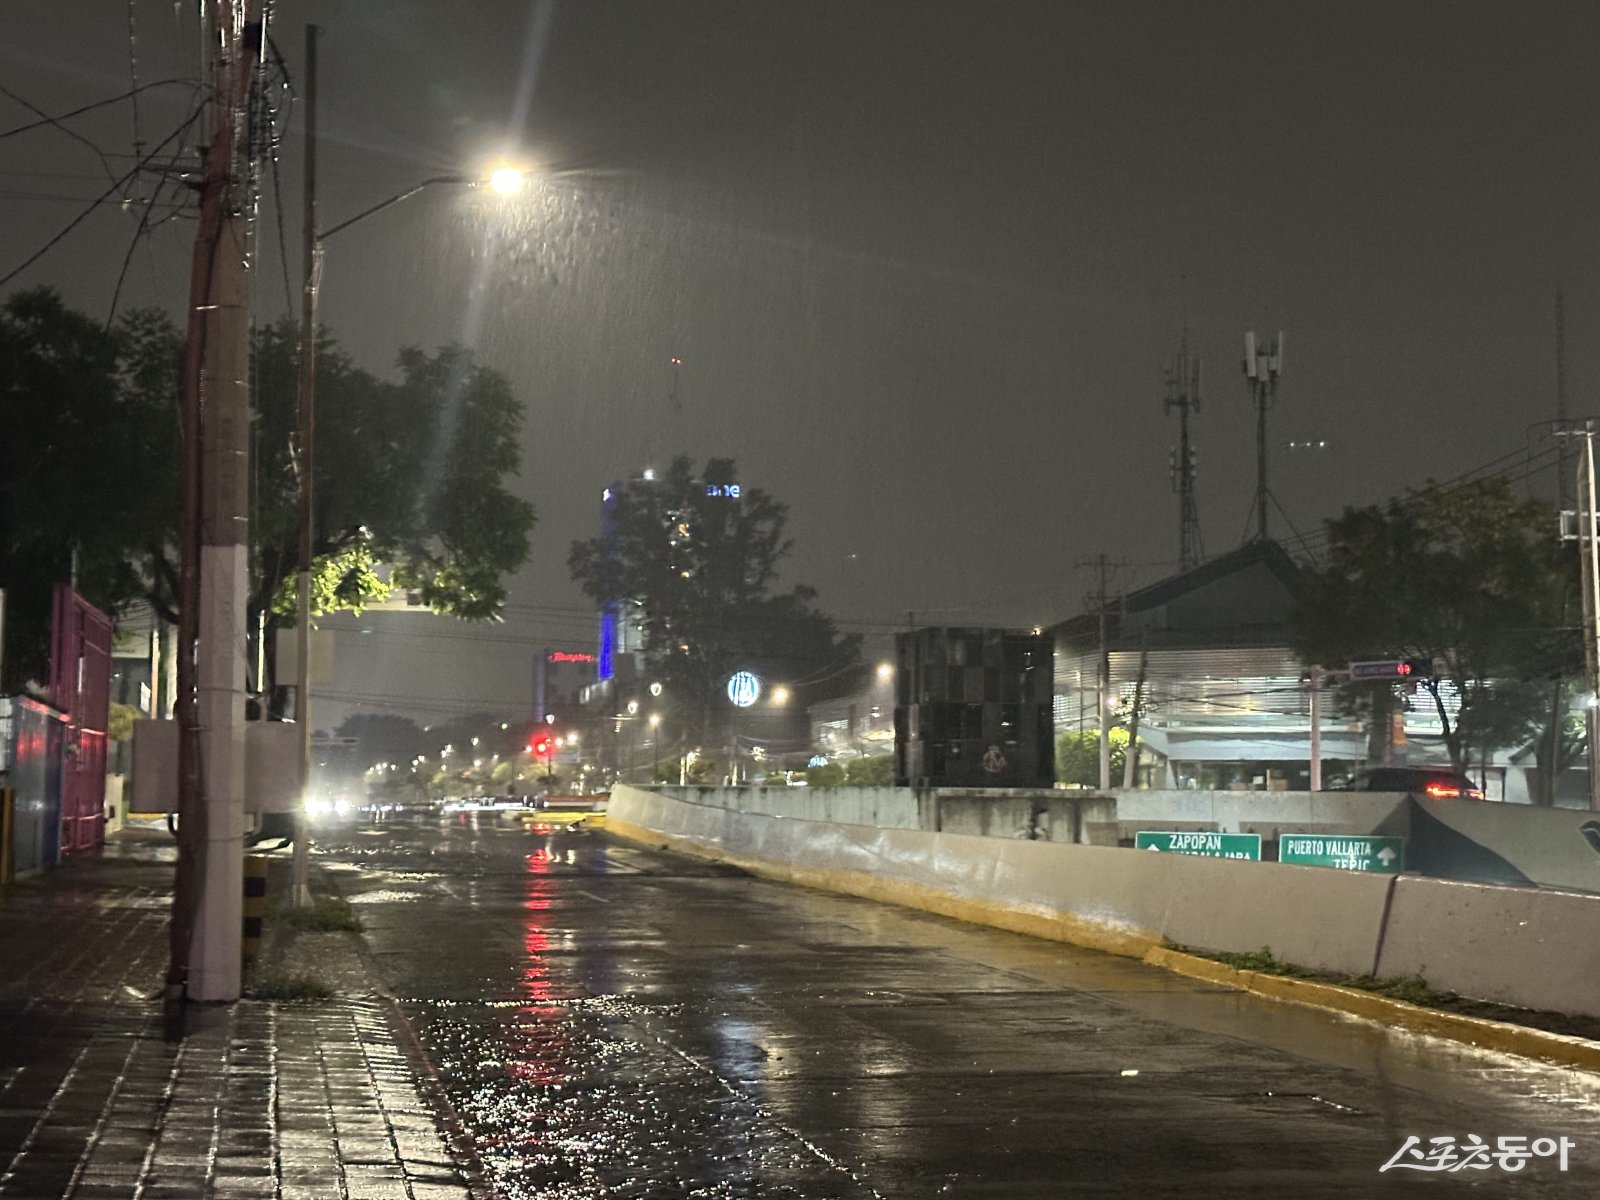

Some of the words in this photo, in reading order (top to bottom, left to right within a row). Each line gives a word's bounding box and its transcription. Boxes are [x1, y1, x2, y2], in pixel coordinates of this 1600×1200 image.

[1169, 834, 1222, 850] ZAPOPAN
[1287, 839, 1324, 855] PUERTO
[1325, 840, 1372, 856] VALLARTA
